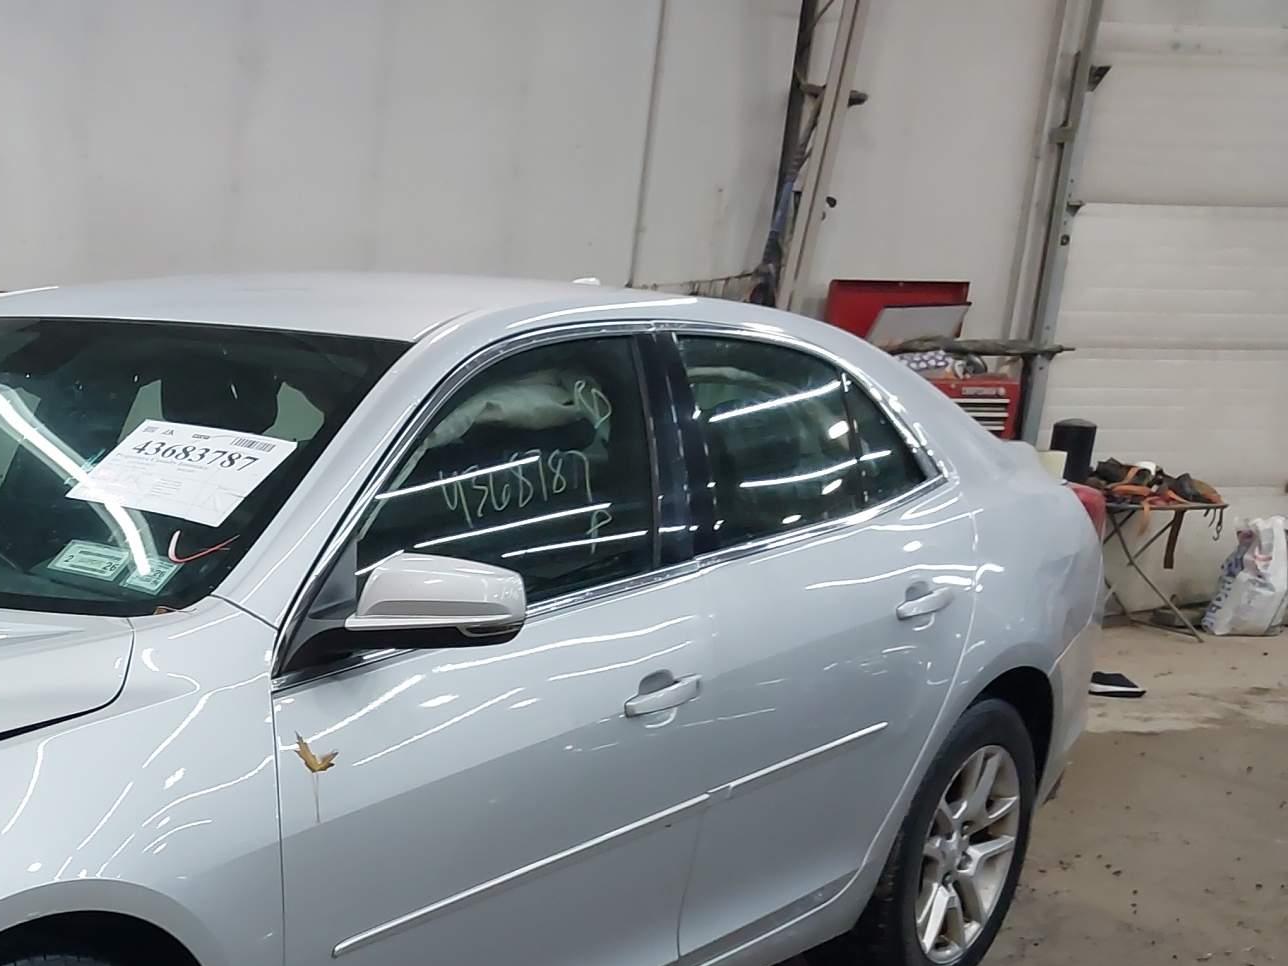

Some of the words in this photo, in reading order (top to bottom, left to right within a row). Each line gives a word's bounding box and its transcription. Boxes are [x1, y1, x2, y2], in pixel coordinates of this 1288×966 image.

[132, 439, 260, 472] 43683787
[63, 554, 74, 563] 2
[102, 561, 119, 572] 26
